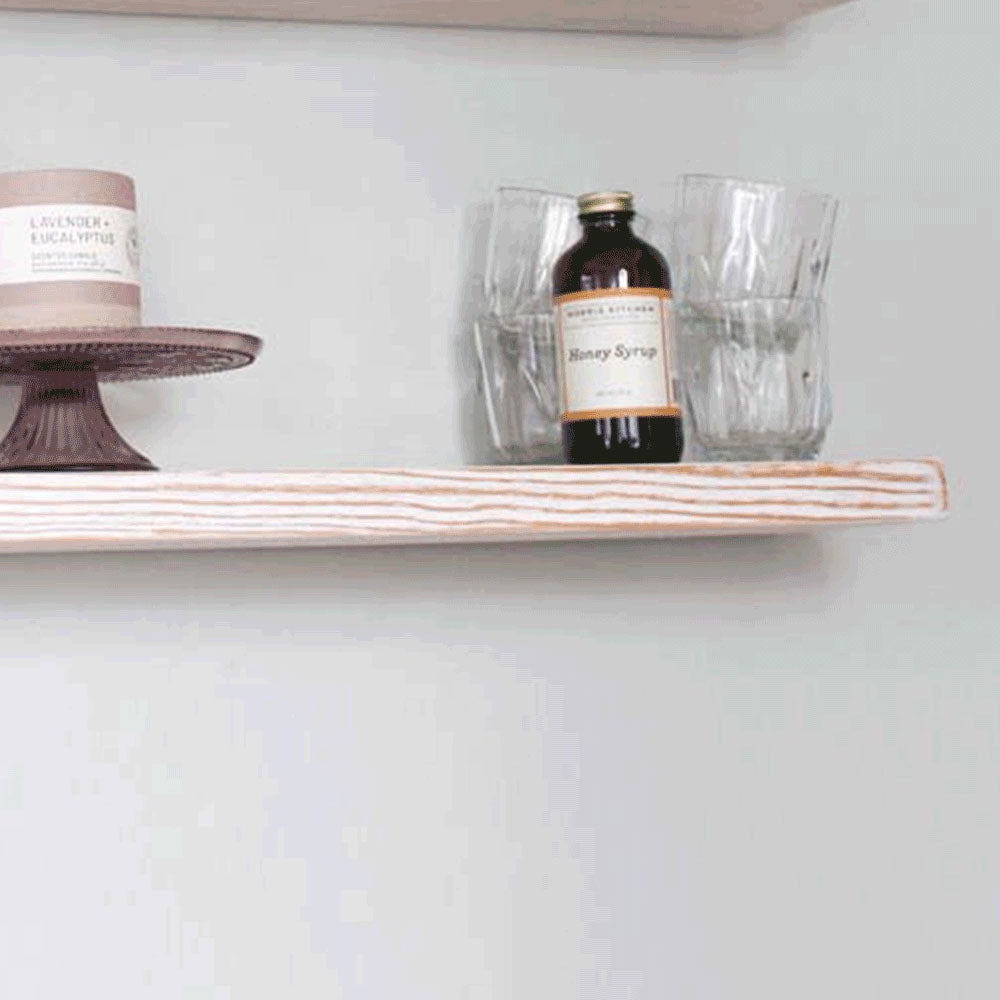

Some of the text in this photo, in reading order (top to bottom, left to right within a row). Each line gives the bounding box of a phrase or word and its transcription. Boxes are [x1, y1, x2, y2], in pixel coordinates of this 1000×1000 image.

[30, 232, 115, 246] EUCALYPTUS
[568, 343, 658, 363] Honey Syrup
